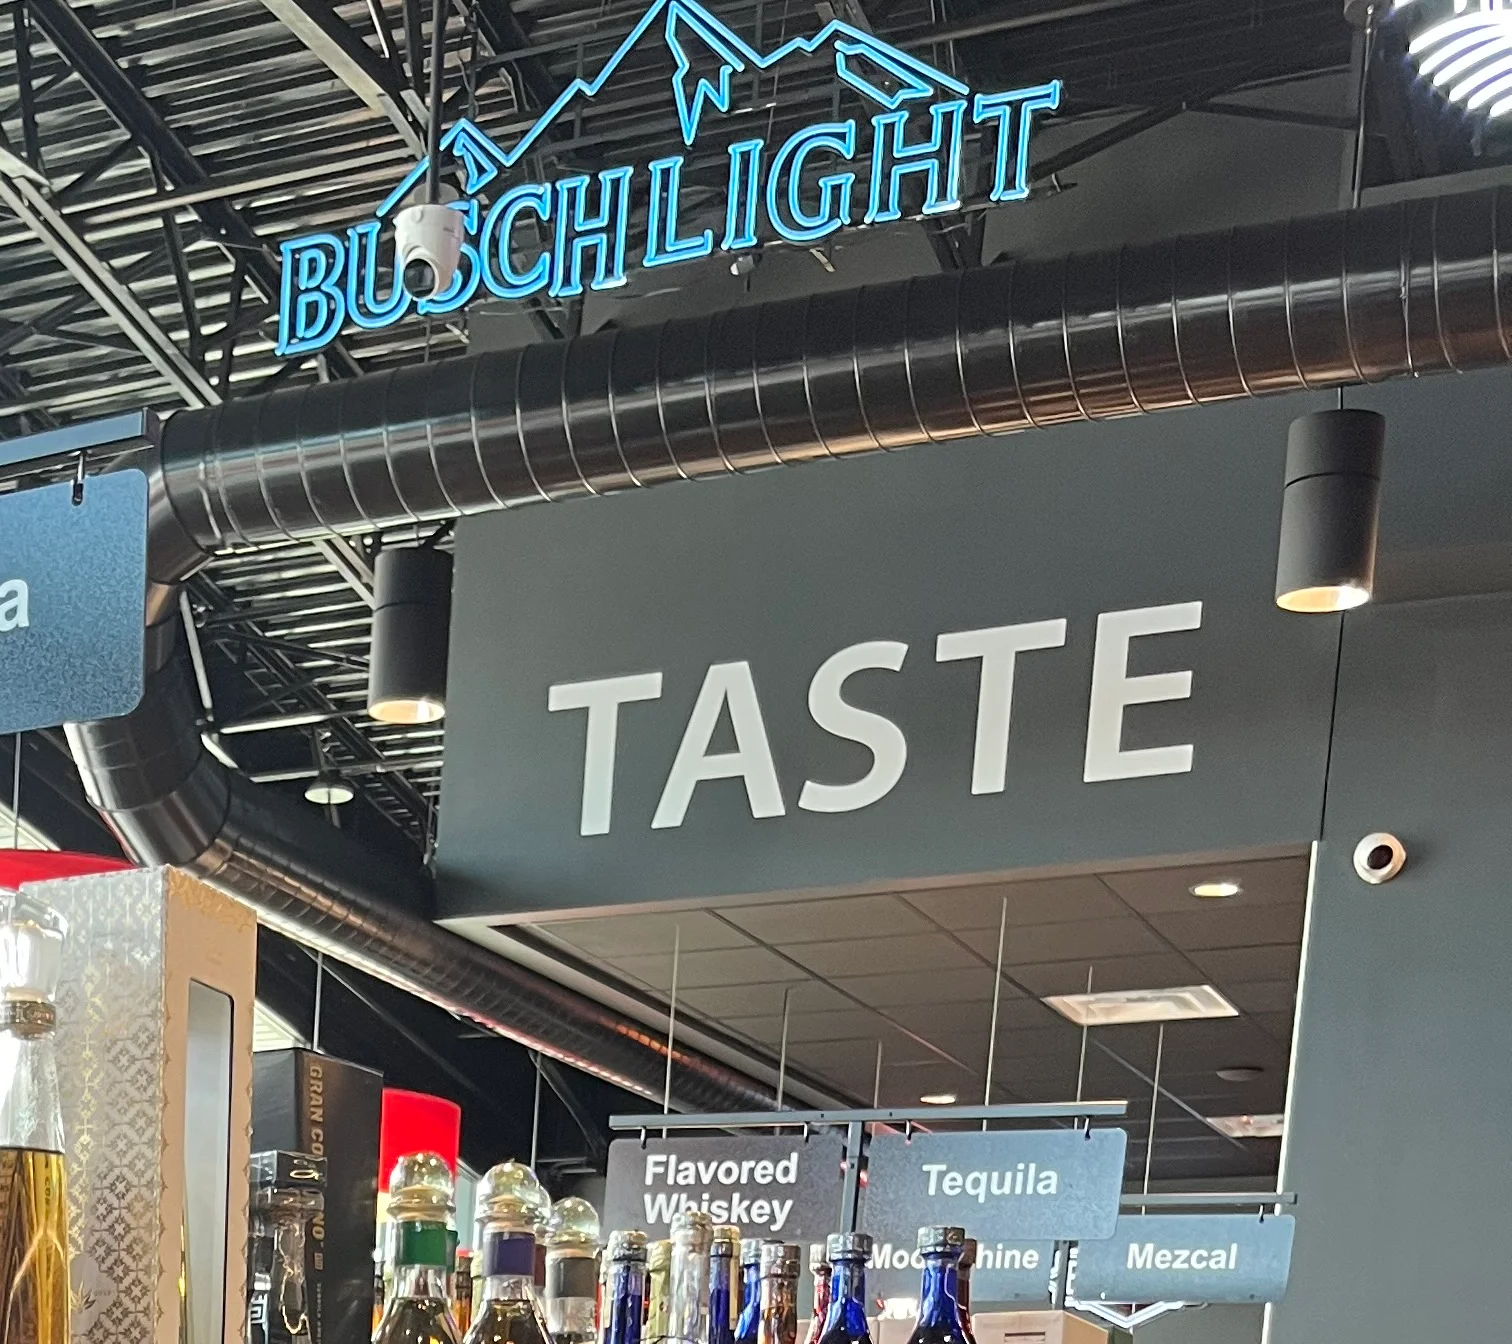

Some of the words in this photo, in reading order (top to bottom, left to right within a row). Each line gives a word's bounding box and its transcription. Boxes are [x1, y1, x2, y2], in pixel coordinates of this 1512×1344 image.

[641, 80, 1062, 269] LIGHT
[547, 601, 1204, 837] TASTE
[309, 1065, 324, 1123] GRAN
[643, 1152, 799, 1189] Flavored
[922, 1163, 1059, 1205] Tequila
[643, 1194, 794, 1232] Whiskey
[868, 1242, 1039, 1270] Moohine
[1126, 1243, 1238, 1270] Mezcal
